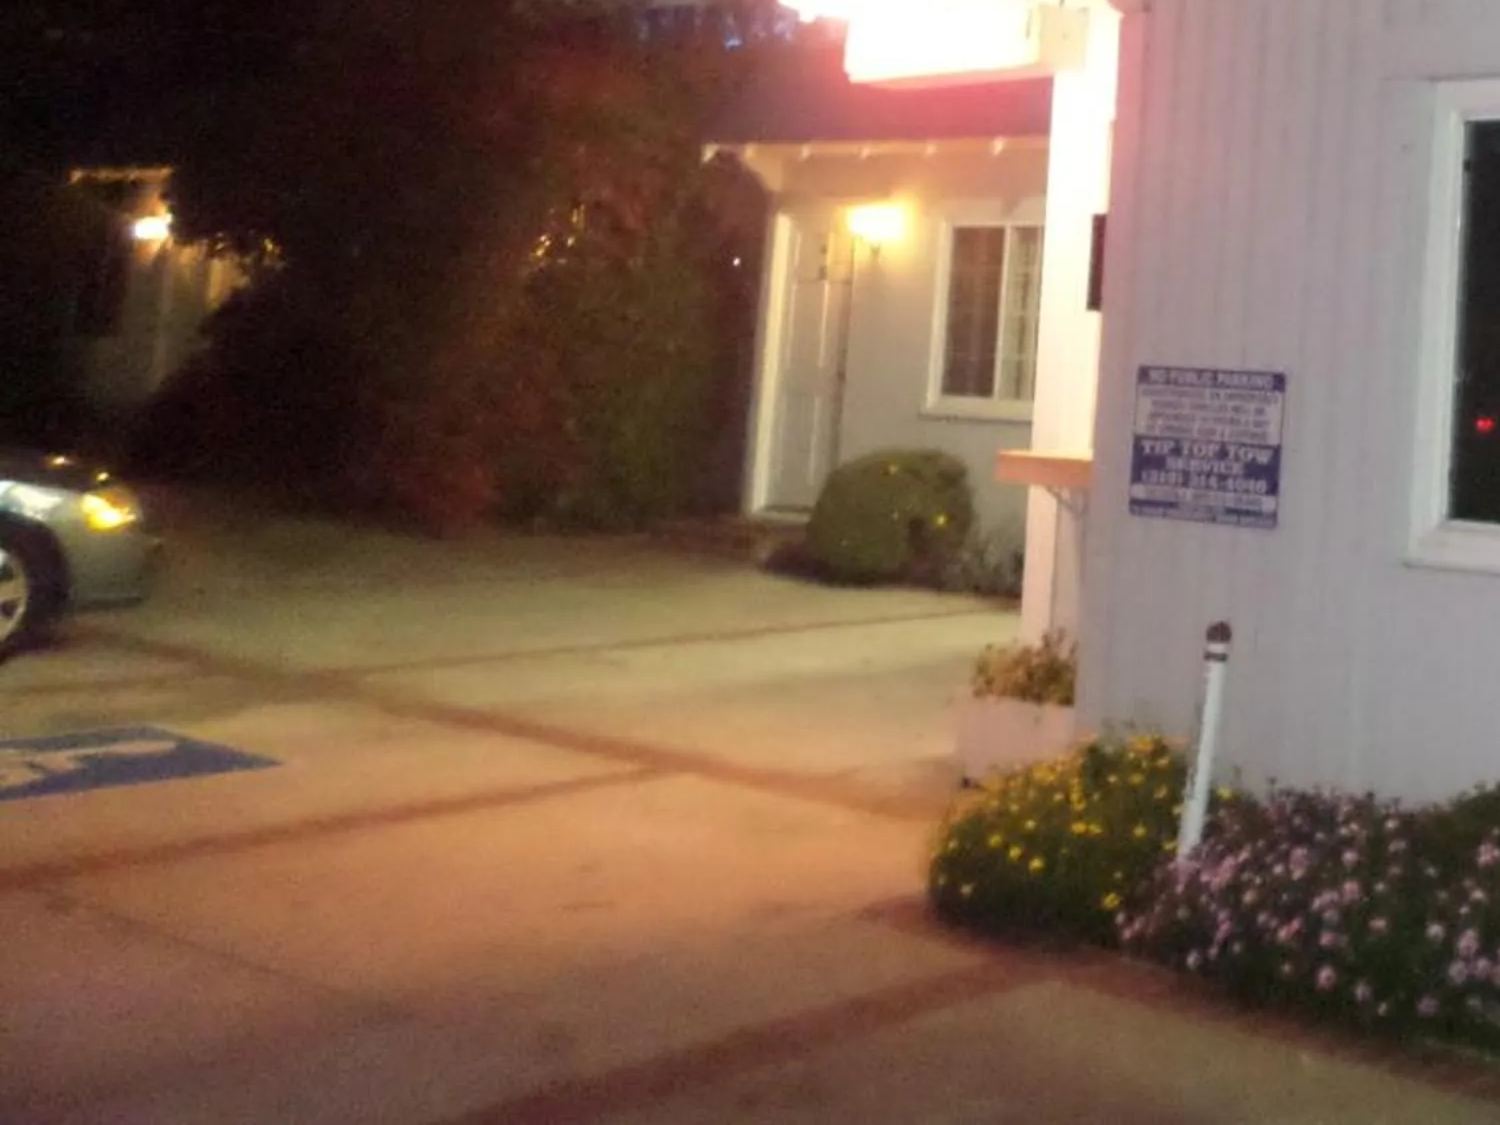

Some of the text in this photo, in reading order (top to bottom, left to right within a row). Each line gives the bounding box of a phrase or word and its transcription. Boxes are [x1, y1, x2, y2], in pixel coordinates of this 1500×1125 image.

[1140, 439, 1274, 465] TIP TOP TOW
[1165, 455, 1246, 475] SERVICE
